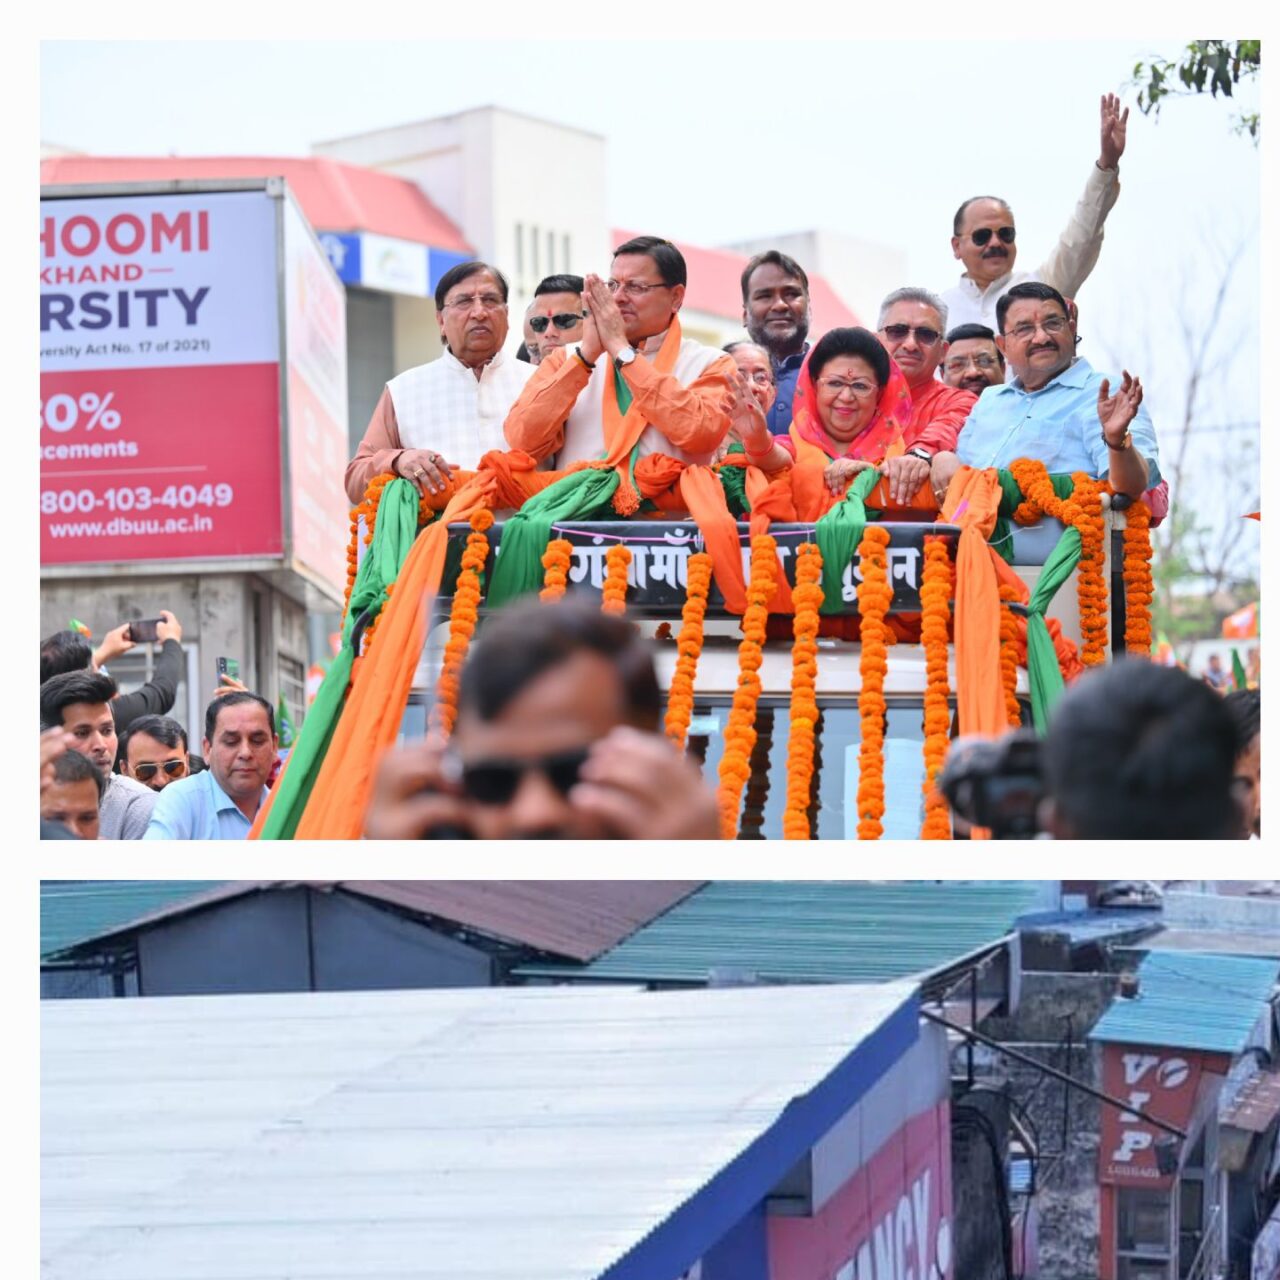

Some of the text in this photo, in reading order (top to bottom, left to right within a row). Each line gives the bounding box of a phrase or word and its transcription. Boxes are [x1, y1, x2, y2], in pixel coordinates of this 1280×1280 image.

[40, 287, 211, 332] RSITY
[85, 343, 107, 355] Act
[112, 342, 134, 354] No.
[139, 341, 152, 351] 17
[156, 340, 170, 350] of
[174, 339, 211, 352] 2021)
[40, 483, 233, 514] 800-103-4049
[49, 513, 213, 538] www.dbuu.ac.in
